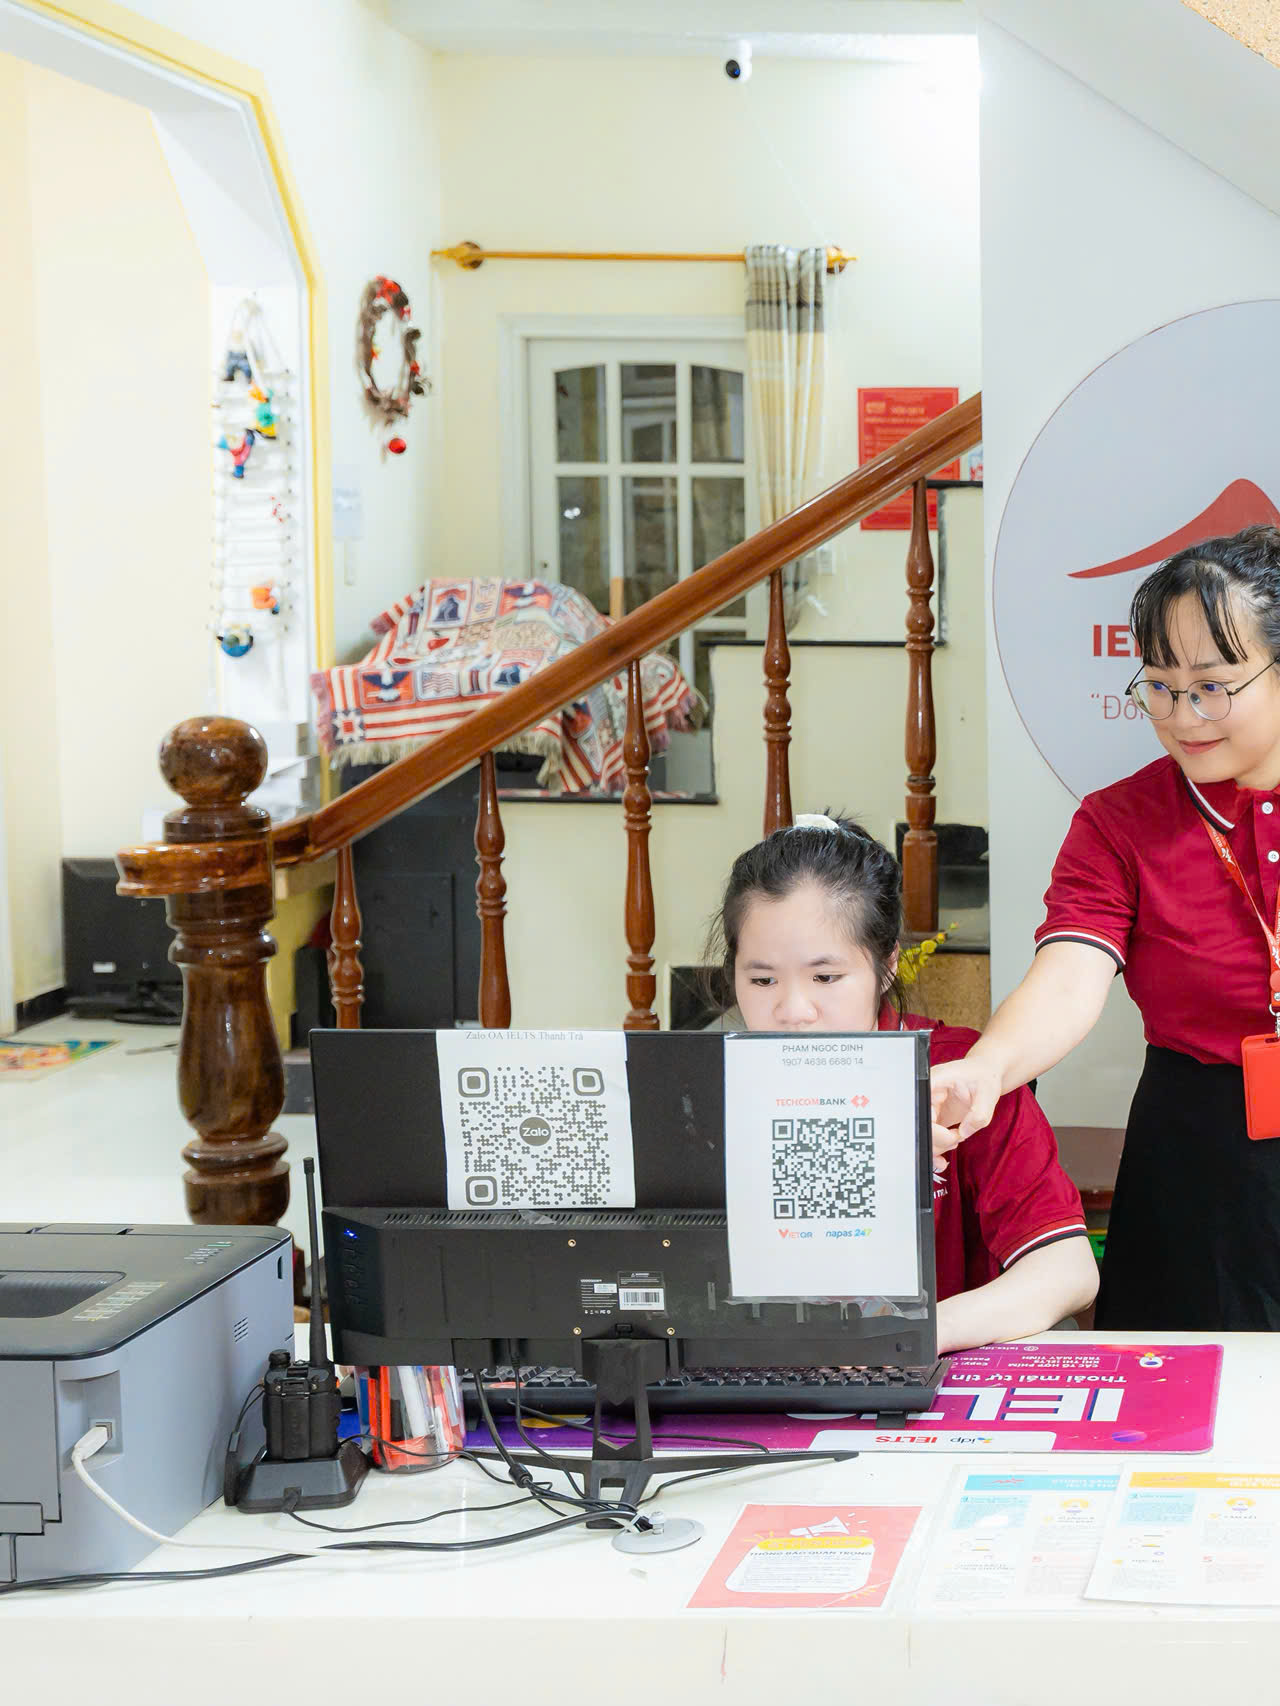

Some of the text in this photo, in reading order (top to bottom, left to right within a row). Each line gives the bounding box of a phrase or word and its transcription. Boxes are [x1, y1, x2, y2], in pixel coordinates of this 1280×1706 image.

[466, 1031, 486, 1040] Zalo
[488, 1031, 504, 1040] OA
[506, 1031, 536, 1040] IELTS
[539, 1031, 566, 1041] Thanh
[782, 1044, 863, 1053] PHAM NGOC DINH
[776, 1098, 847, 1107] TECHCOMBANK
[522, 1127, 550, 1137] Zalo
[826, 1230, 852, 1239] napas
[951, 1374, 980, 1382] tin
[875, 1436, 938, 1444] IELTS
